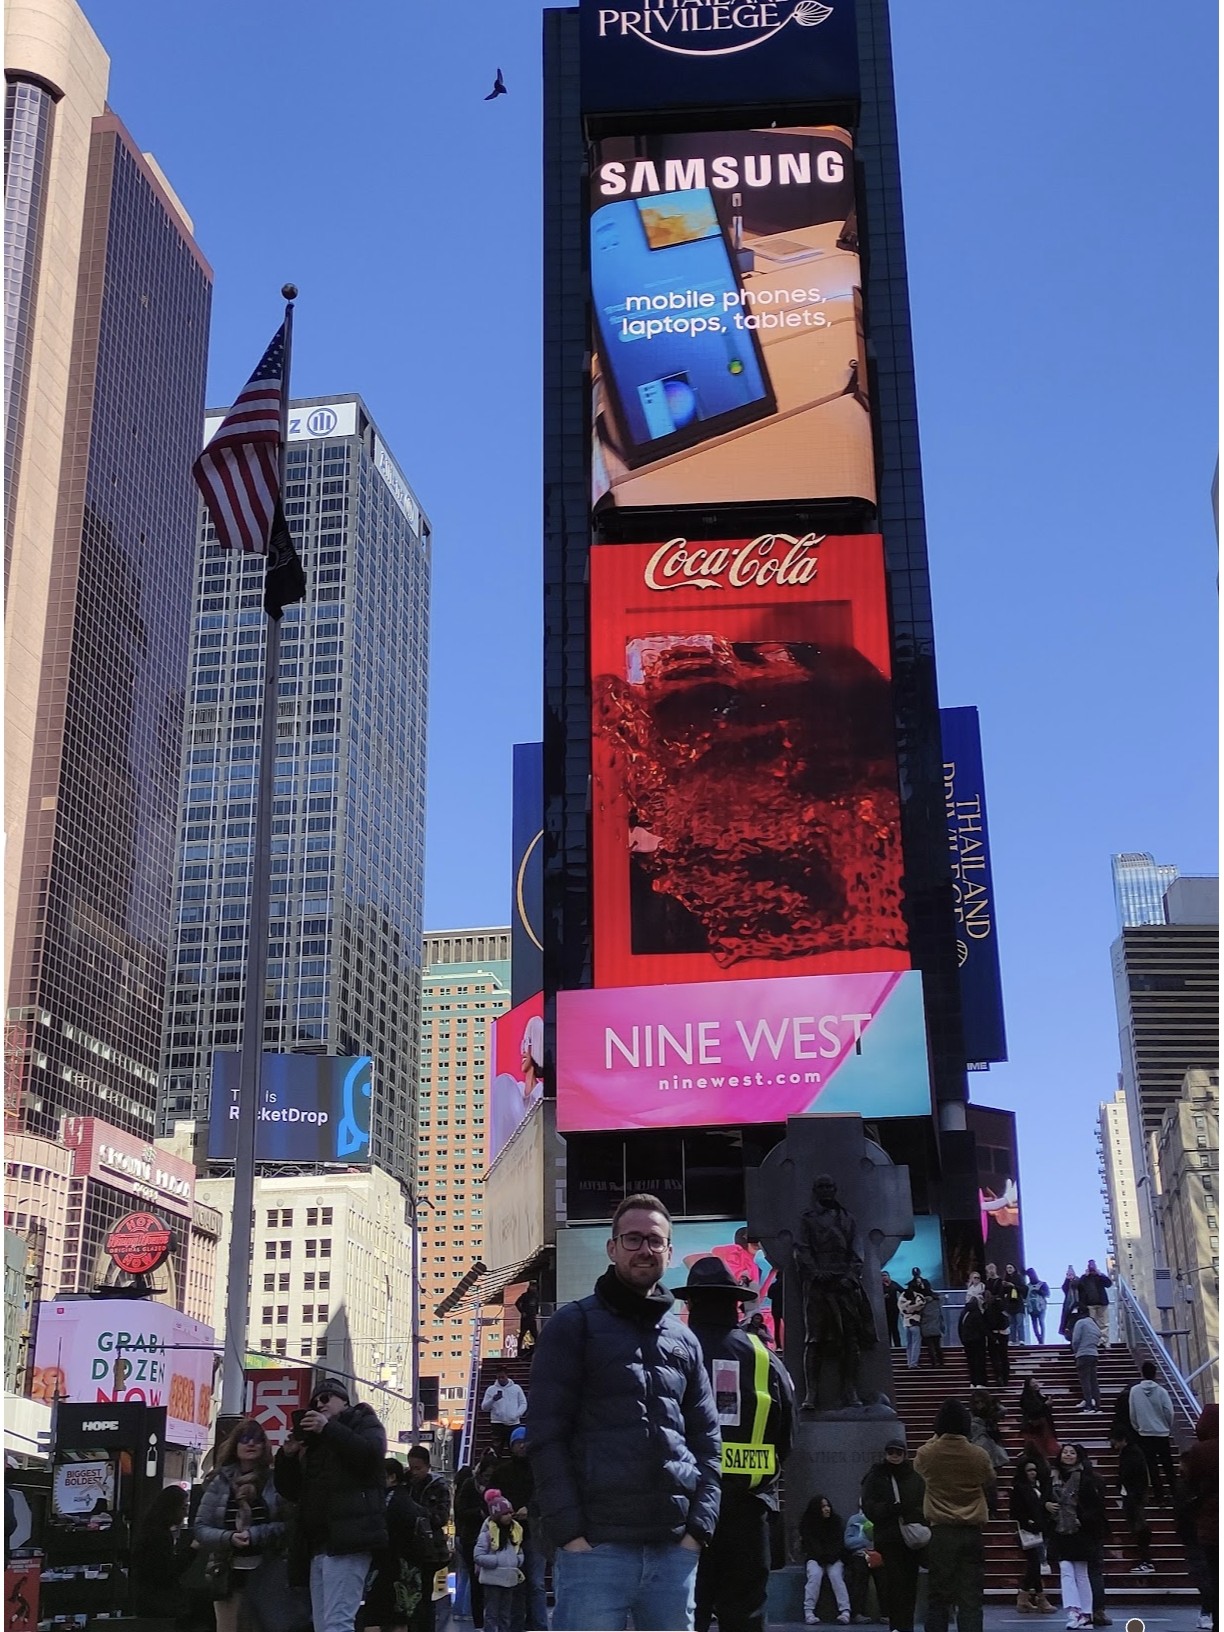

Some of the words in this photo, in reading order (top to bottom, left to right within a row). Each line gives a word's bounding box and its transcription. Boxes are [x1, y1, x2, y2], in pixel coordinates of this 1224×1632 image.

[599, 4, 781, 36] PRIVILEGE
[600, 150, 845, 195] SAMSUNG
[626, 289, 716, 312] mobile
[723, 287, 827, 312] phones,
[622, 317, 727, 340] laptops,
[733, 309, 833, 330] tablets,
[956, 793, 991, 940] THAILAND
[605, 1021, 721, 1069] NINE
[735, 1013, 872, 1061] WEST
[966, 1061, 988, 1071] IME
[658, 1072, 821, 1090] ninewest.com
[265, 1090, 277, 1103] is
[229, 1105, 329, 1127] RketDrop
[126, 1216, 154, 1231] HOT
[122, 1253, 153, 1268] NOW
[97, 1387, 161, 1406] NOW
[81, 1420, 119, 1431] HOPE
[255, 1375, 299, 1456] tkt
[725, 1448, 769, 1469] SAFETY
[64, 1476, 103, 1487] BOLDEST
[66, 1469, 102, 1479] BIGGEST
